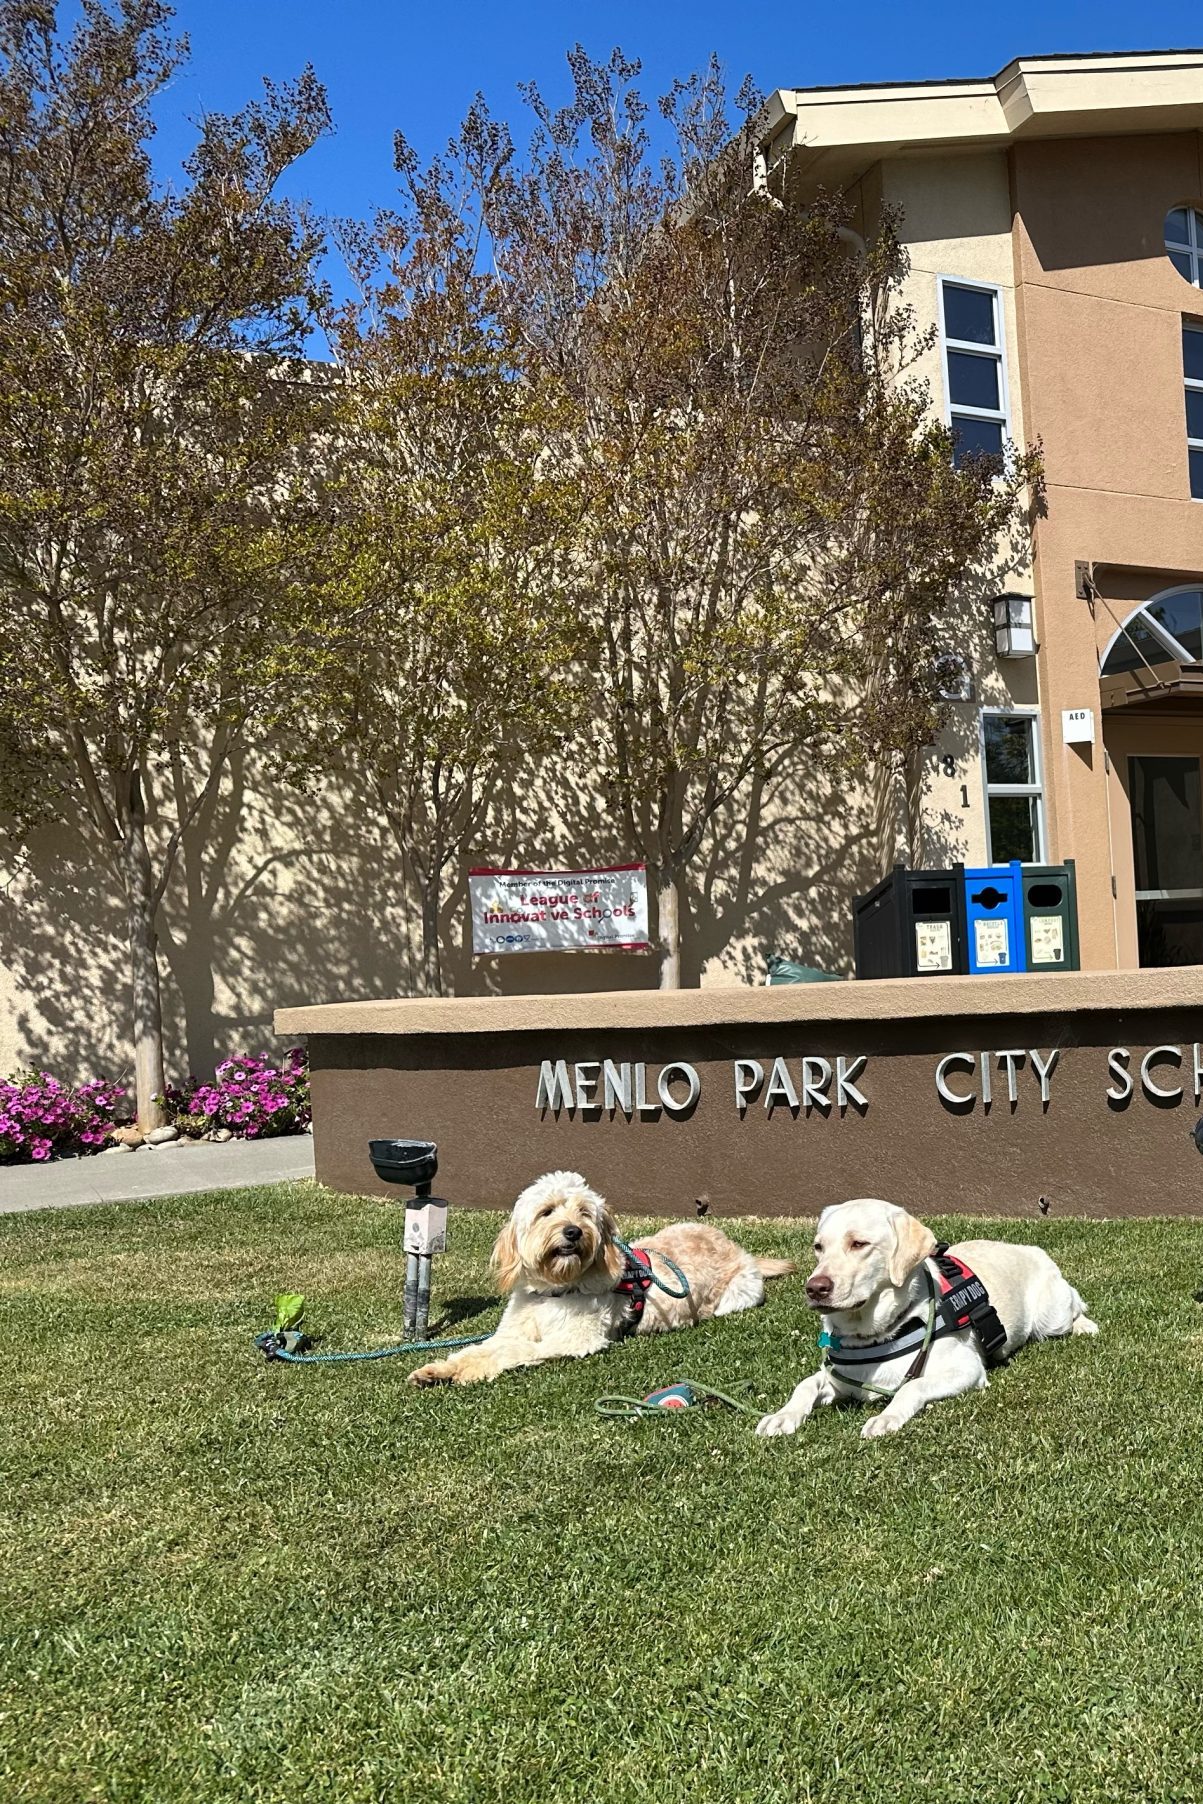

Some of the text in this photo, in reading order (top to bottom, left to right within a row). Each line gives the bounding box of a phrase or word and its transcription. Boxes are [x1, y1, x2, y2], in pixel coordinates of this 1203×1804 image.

[1069, 712, 1086, 721] AED
[558, 878, 583, 887] Digital
[520, 891, 600, 908] League of
[484, 905, 636, 925] Innovatve Schools
[535, 1059, 700, 1113] MENLO
[735, 1055, 868, 1108] PARK
[935, 1049, 1060, 1105] CITY
[966, 1281, 986, 1300] DOG
